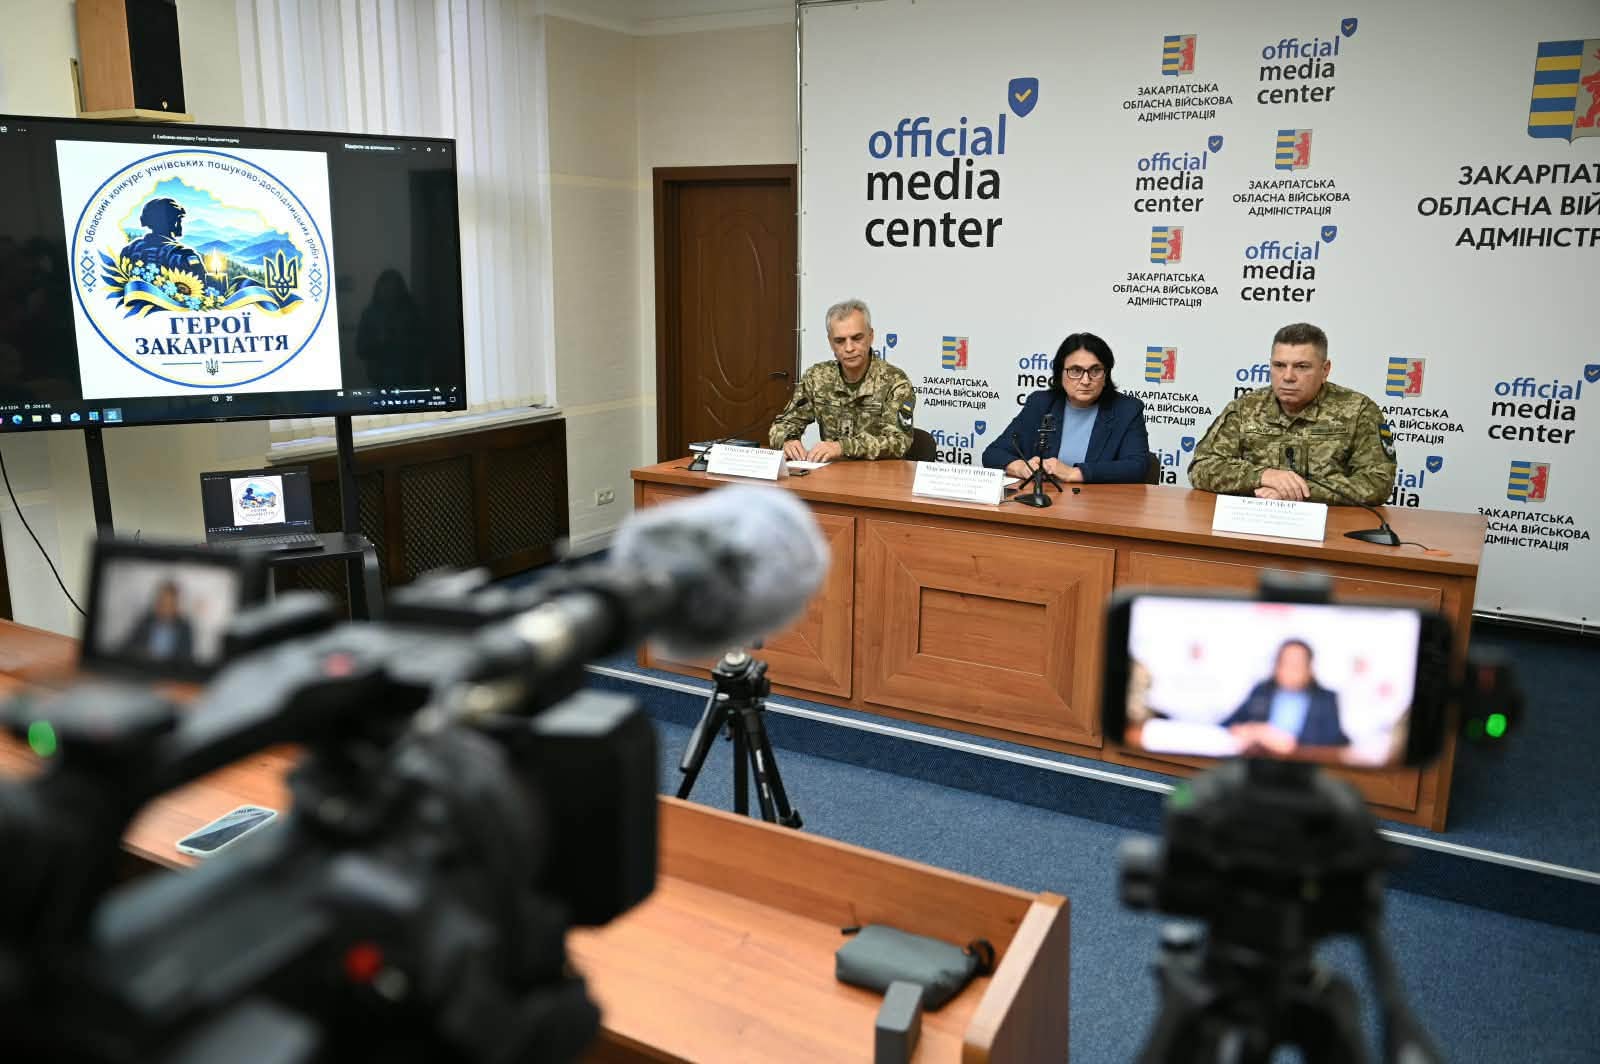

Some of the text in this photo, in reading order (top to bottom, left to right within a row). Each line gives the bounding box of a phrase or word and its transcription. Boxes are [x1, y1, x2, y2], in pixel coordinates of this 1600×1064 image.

[1262, 35, 1340, 60] official
[1259, 58, 1335, 81] media
[1138, 83, 1219, 96] ЗАКАРПАТСЬКА
[1257, 83, 1335, 105] center
[1123, 96, 1233, 110] ОБЛАСНА ВІЙСЬКОВА
[1138, 110, 1216, 122] АДМІНІСТРАЦІЯ
[868, 113, 1006, 160] official
[1137, 151, 1207, 171] official
[867, 158, 1001, 201] media
[1135, 171, 1204, 191] media
[1248, 179, 1336, 190] ЗАКАРПАТСЬКА
[84, 199, 111, 243] Обласний
[108, 171, 144, 200] конкурс
[145, 160, 204, 176] учнівських
[1133, 196, 1204, 212] center
[1232, 191, 1351, 203] ОБЛАСНА ВІЙСЬКОВА
[1417, 196, 1552, 216] ОБЛАСНА
[1248, 206, 1331, 217] АДМІНІСТРАЦІЯ
[865, 211, 1003, 249] center
[1245, 241, 1320, 261] official
[1127, 272, 1205, 282] ЗАКАРПАТСЬКА
[1242, 260, 1316, 280] media
[1112, 284, 1218, 295] ОБЛАСНА ВІЙСЬКОВА
[1241, 284, 1315, 302] center
[1127, 297, 1202, 308] АДМІНІСТРАЦІЯ
[168, 312, 252, 335] ГЕРОЇ
[135, 335, 289, 355] ЗАКАРПАТТЯ
[923, 377, 989, 387] ЗАКАРПАТСЬКА
[1495, 377, 1582, 400] official
[953, 388, 1000, 399] ВІЙСЬКОВА
[923, 398, 986, 410] АДМІНІСТРАЦІЯ
[1157, 403, 1212, 415] ВІЙСЬКОВА
[1382, 406, 1449, 418] АРПАТСЬКА
[1491, 399, 1576, 420] media
[1144, 415, 1195, 426] ІНІСТРАЦІЯ
[1400, 419, 1464, 433] ВІЙСЬКОВА
[930, 430, 974, 448] fficial
[1391, 432, 1445, 445] ІСТРАЦІЯ
[1488, 424, 1576, 444] center
[935, 447, 972, 464] edia
[1384, 487, 1419, 507] dia
[1478, 507, 1574, 525] ЗАКАРПАТСЬКА
[1521, 524, 1590, 540] ВІЙСЬКОВА
[1484, 534, 1569, 552] ДМІНІСТРАЦІЯ
